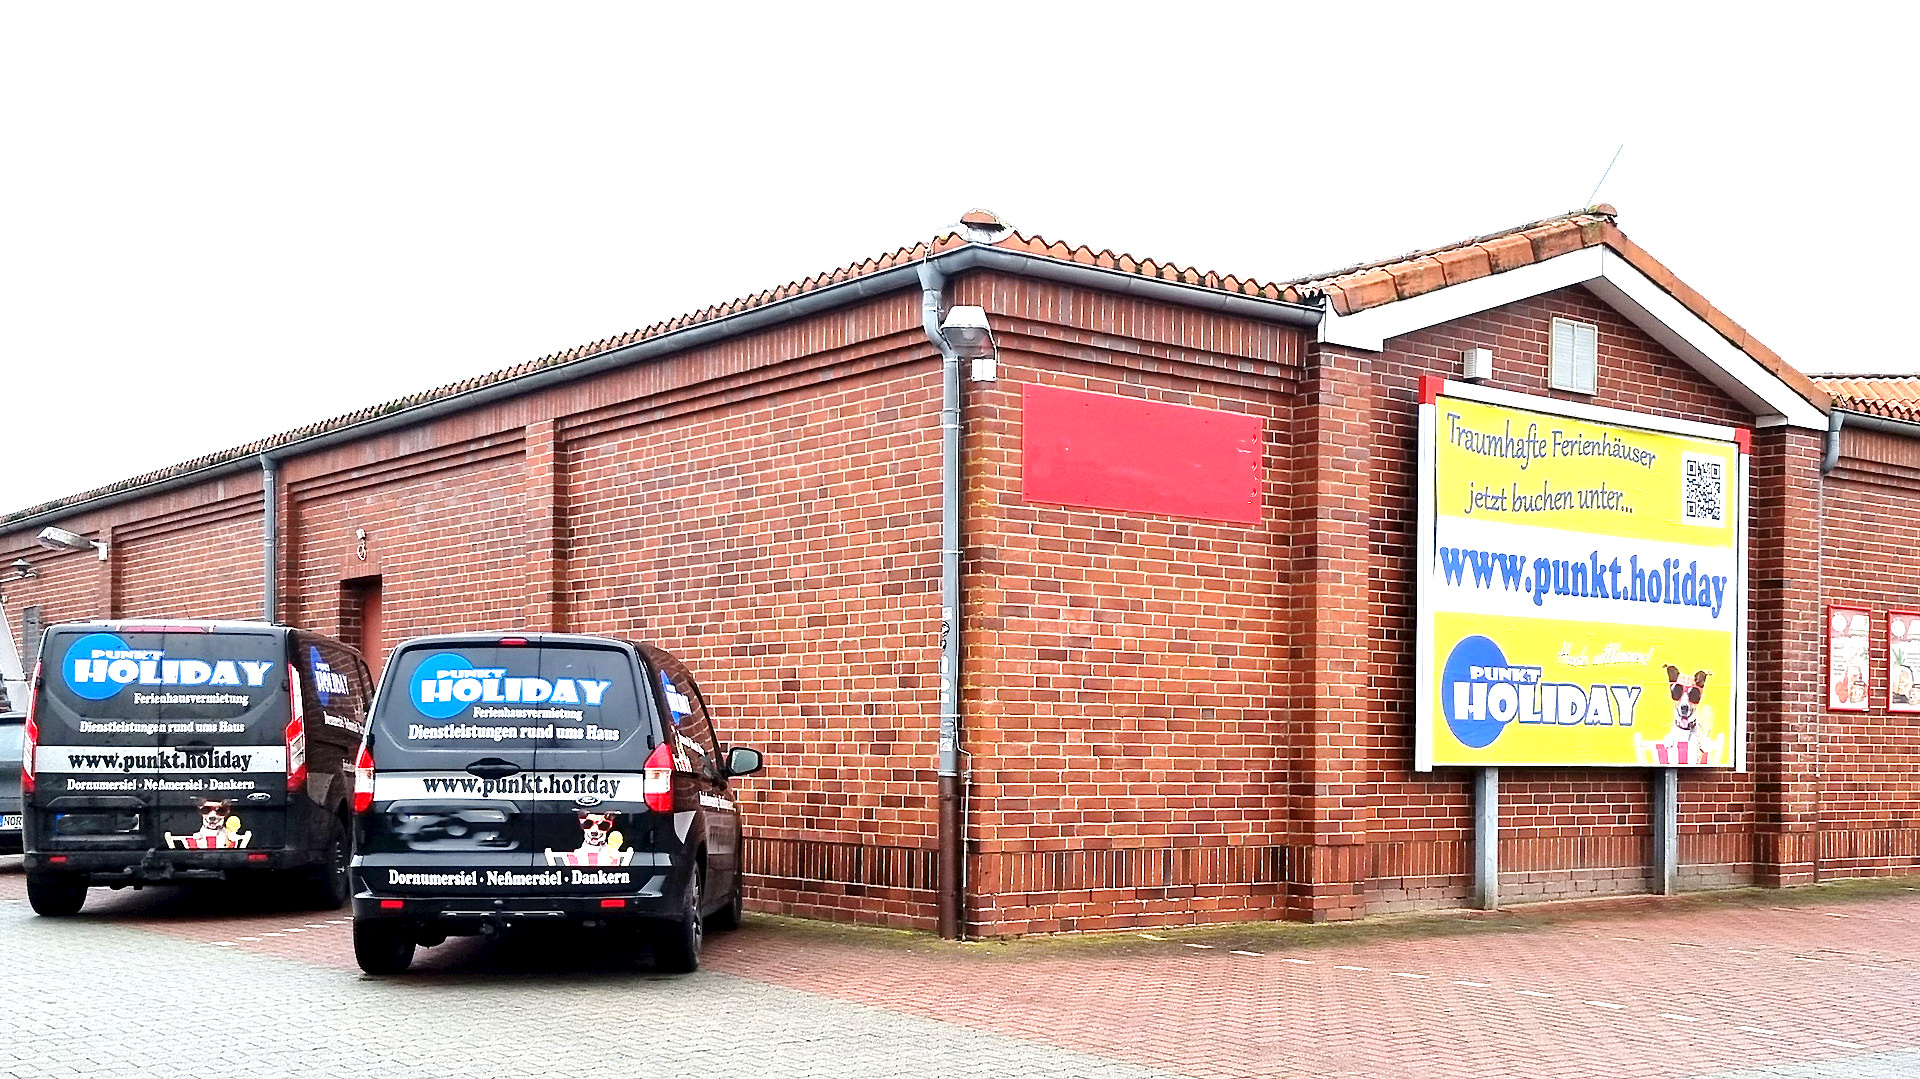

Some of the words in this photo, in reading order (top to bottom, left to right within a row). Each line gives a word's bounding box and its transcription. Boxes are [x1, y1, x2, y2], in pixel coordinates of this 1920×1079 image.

[1446, 412, 1546, 470] Traumhafte
[1551, 430, 1656, 469] Ferienhäuser
[1464, 483, 1508, 514] jetzt
[1511, 481, 1574, 513] buchen
[1578, 482, 1633, 514] unter...
[1440, 546, 1727, 619] www.punkt.holiday
[91, 650, 165, 660] PUNKT
[74, 659, 273, 686] HOLIDAY
[436, 669, 507, 679] PUNKT
[1469, 665, 1542, 682] PUNKT
[133, 692, 249, 706] Ferienhausvermietung
[421, 679, 611, 705] HOLIDAY
[1453, 681, 1641, 726] HOLIDAY
[473, 706, 583, 721] Ferienhausvermietung
[80, 720, 166, 733] Dienstleistungen
[167, 721, 194, 733] rund
[196, 723, 218, 732] ums
[219, 721, 245, 733] Haus
[408, 724, 517, 741] Dienstleistungen
[520, 724, 553, 739] rund
[556, 727, 584, 740] ums
[586, 725, 619, 741] Haus
[68, 751, 252, 773] www.punkt.holiday
[67, 779, 137, 790] Dornumersiel
[209, 779, 255, 791] Dankern
[424, 774, 621, 798] www.punkt.holiday
[388, 869, 478, 886] Dornumersiel
[487, 870, 562, 886] Neßmersiel
[571, 869, 630, 885] Dankern
